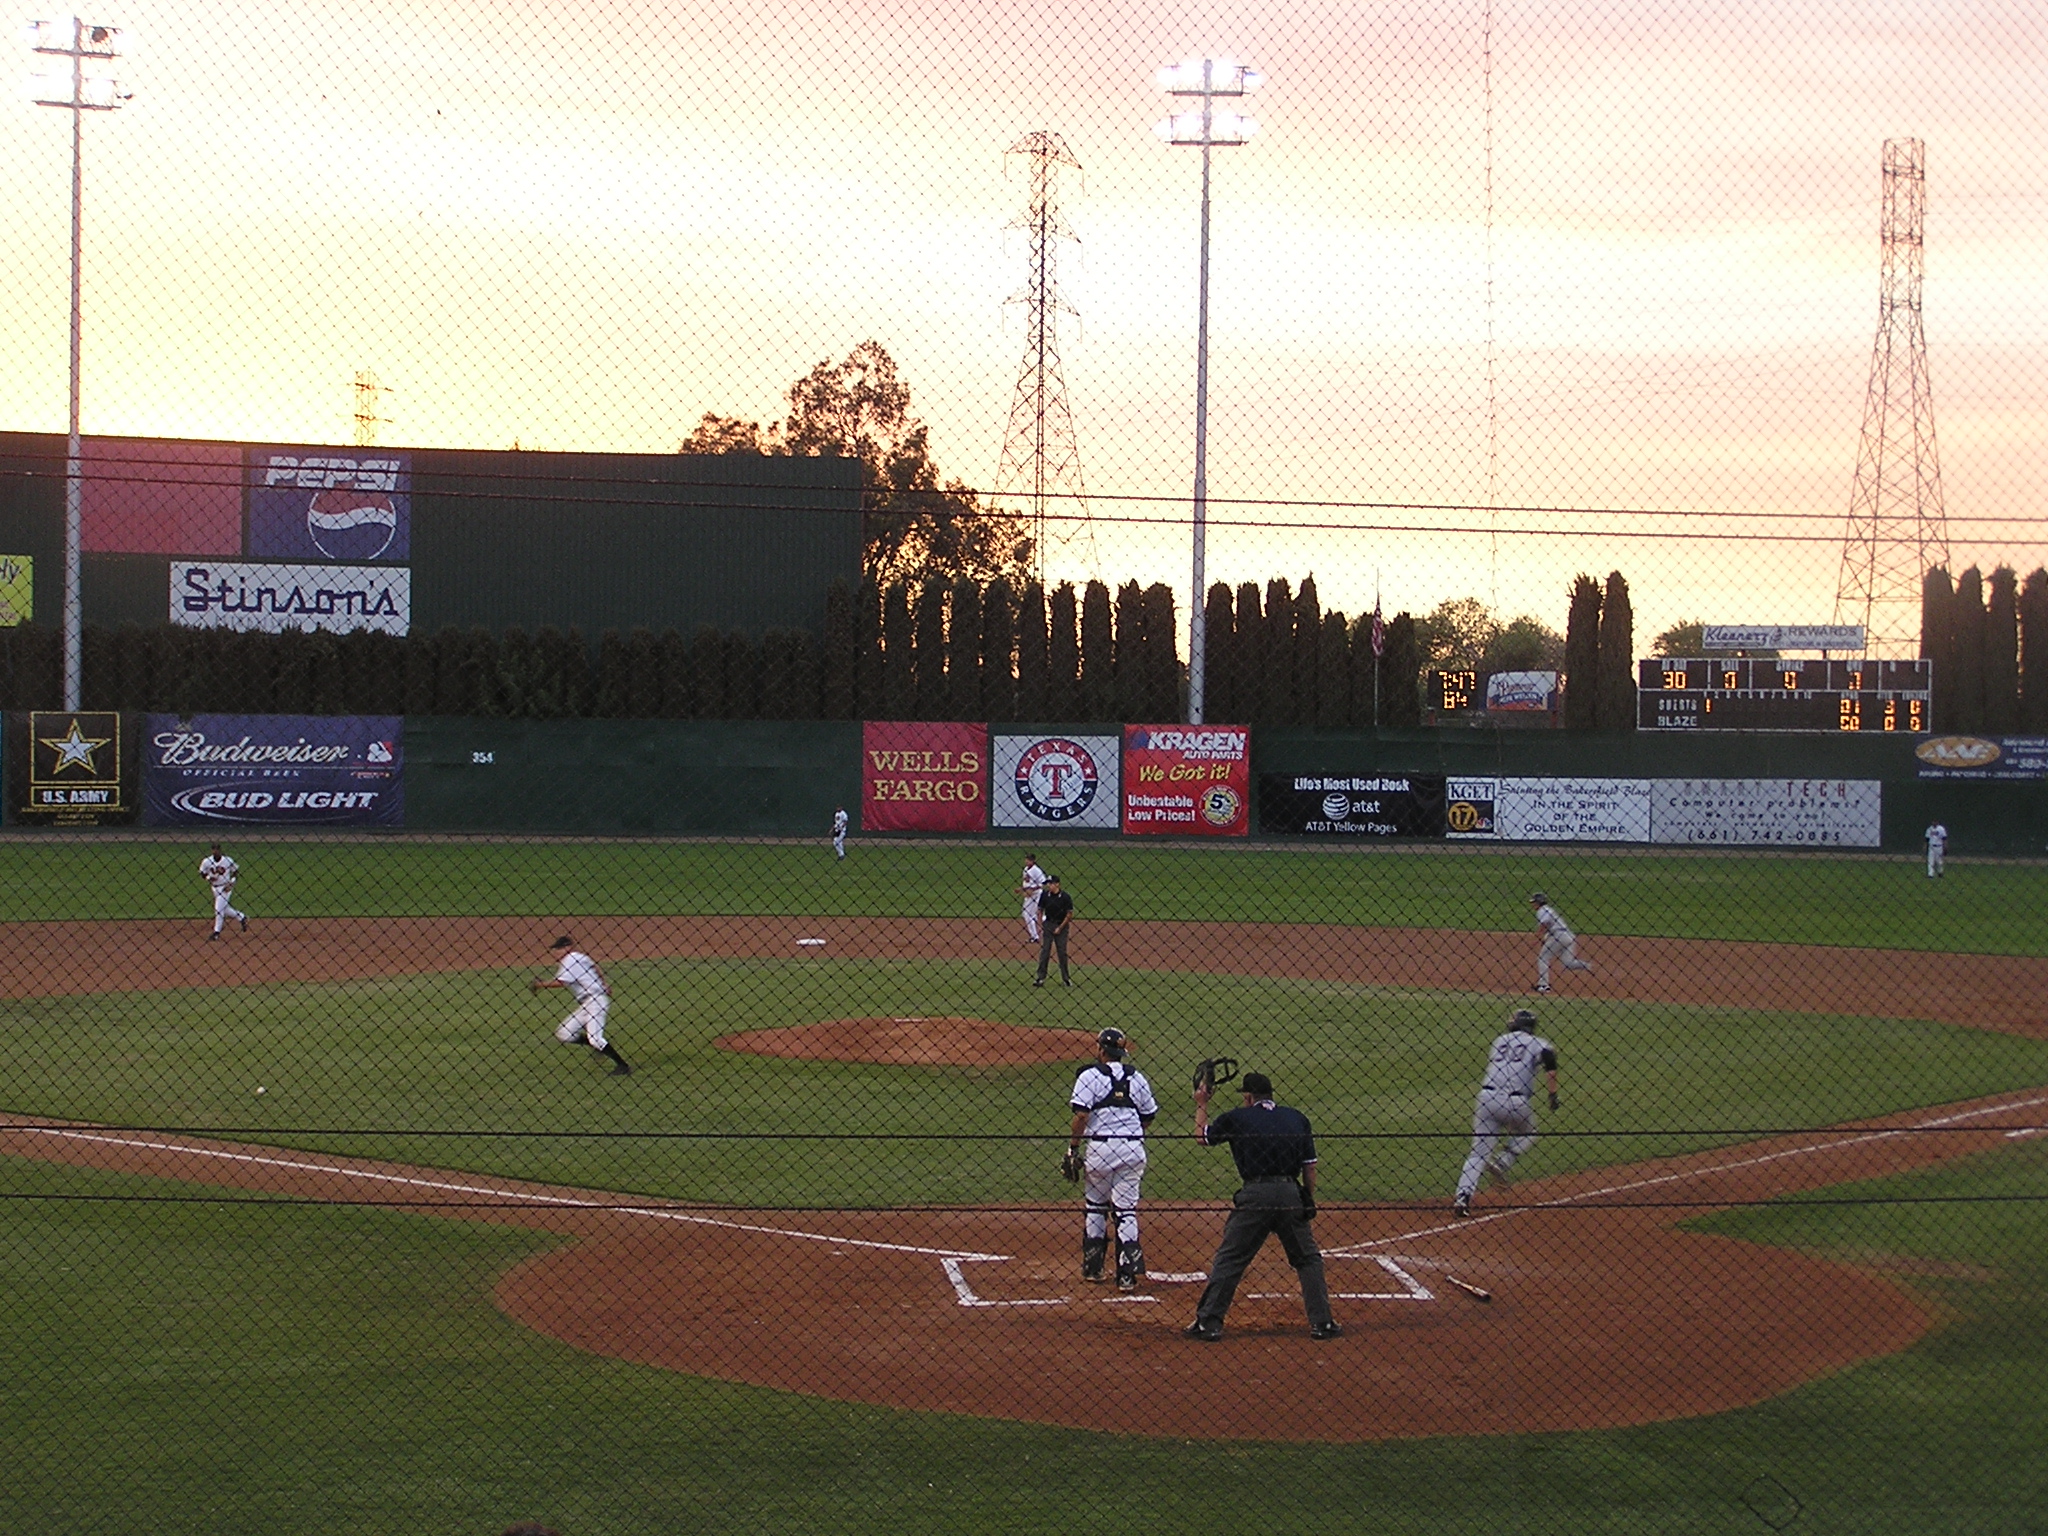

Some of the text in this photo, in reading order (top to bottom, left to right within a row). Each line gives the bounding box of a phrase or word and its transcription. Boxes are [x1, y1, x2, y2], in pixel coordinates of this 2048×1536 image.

[266, 456, 400, 491] PEPSI
[1662, 671, 1686, 689] 30
[1658, 699, 1698, 711] GUESTS
[1657, 716, 1698, 727] BLAZE
[154, 733, 349, 765] Budweiser
[1147, 731, 1247, 751] KRAGEN
[869, 750, 980, 772] WELLS
[1027, 742, 1088, 764] TEXAS
[1182, 750, 1244, 760] AUTO PARTS
[1139, 762, 1232, 782] We Got it!
[1041, 764, 1073, 799] T
[1294, 777, 1410, 792] Life's Most Used Book
[42, 790, 109, 803] U.S. ARMY
[873, 780, 980, 802] FARGO
[1451, 785, 1491, 799] KGET
[200, 792, 379, 810] BUD LIGHT
[1020, 785, 1093, 818] RANGERS
[1127, 794, 1194, 807] Unbeatable
[1352, 799, 1381, 813] at&t
[1669, 798, 1755, 809] Computer
[1127, 808, 1196, 822] Low Prices!
[1451, 804, 1475, 827] 17
[1305, 821, 1398, 835] AT&T Yellow Pages
[1688, 829, 1739, 841] (661)
